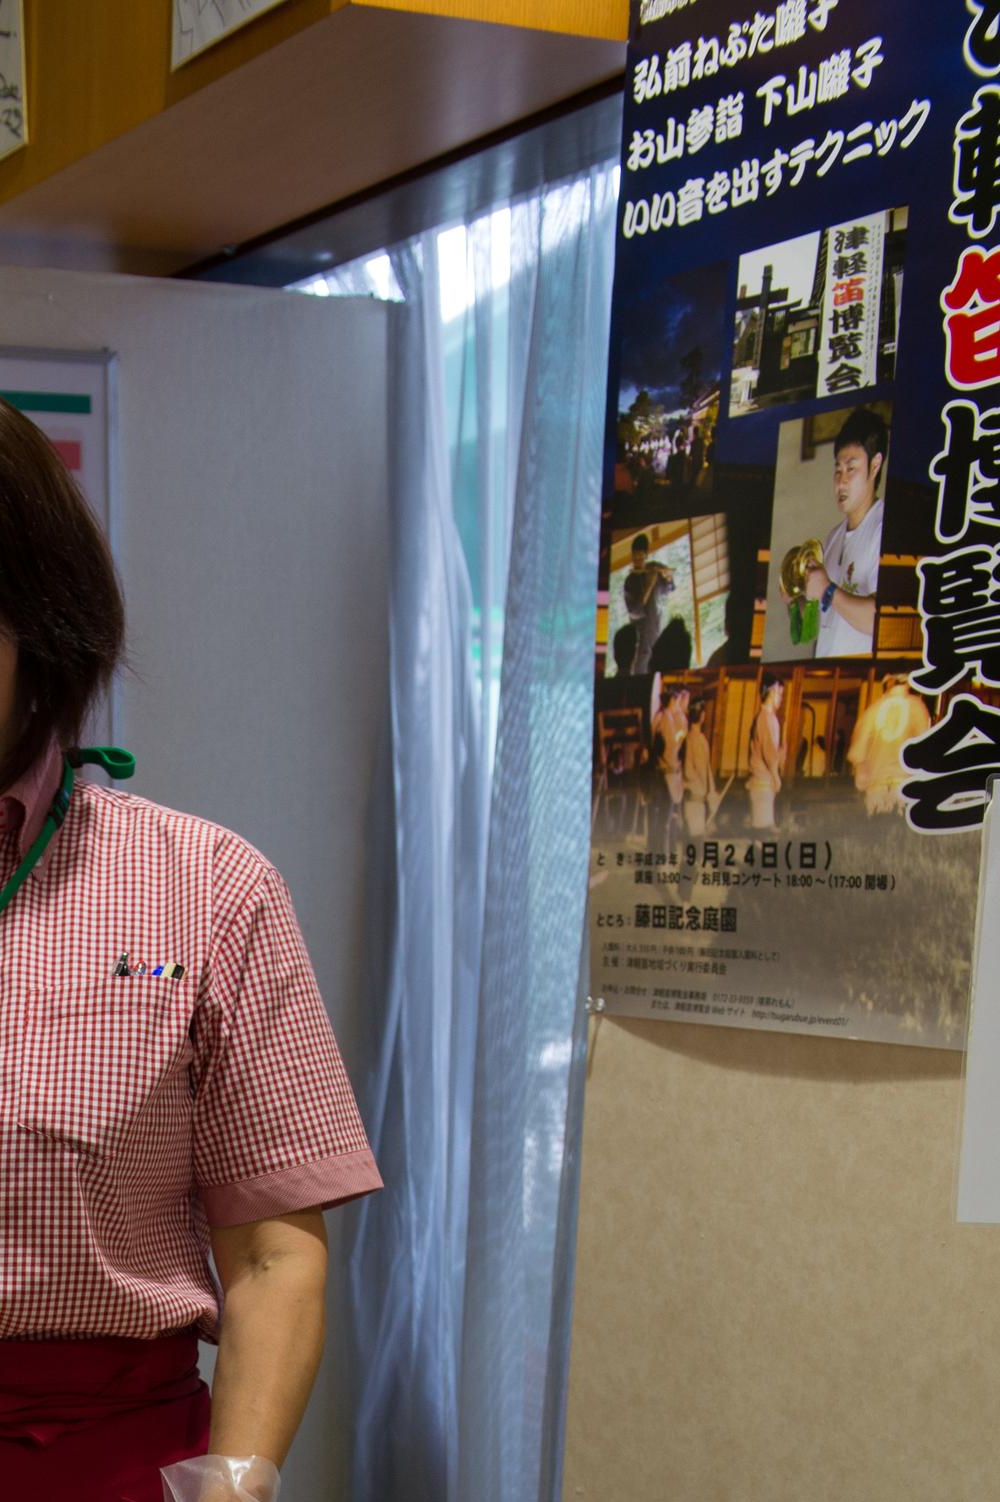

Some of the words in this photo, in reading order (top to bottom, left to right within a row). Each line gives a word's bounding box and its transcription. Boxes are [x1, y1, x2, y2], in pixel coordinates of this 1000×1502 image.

[622, 98, 932, 239] いい音を出すテクニック
